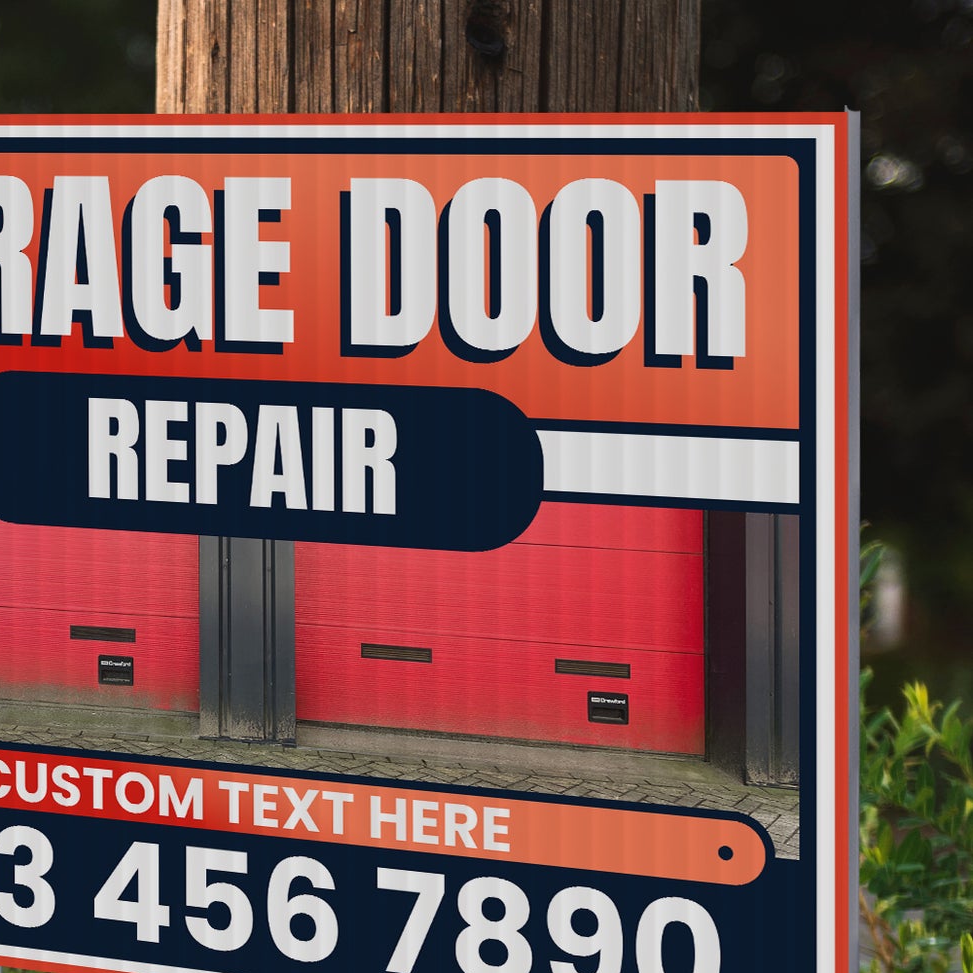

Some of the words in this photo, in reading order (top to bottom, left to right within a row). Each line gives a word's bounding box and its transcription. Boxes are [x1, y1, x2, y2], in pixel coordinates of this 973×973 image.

[347, 177, 749, 359] DOOR
[88, 397, 398, 515] REPAIR
[218, 780, 355, 836] TEXT
[369, 795, 511, 853] HERE
[93, 841, 339, 963] 456
